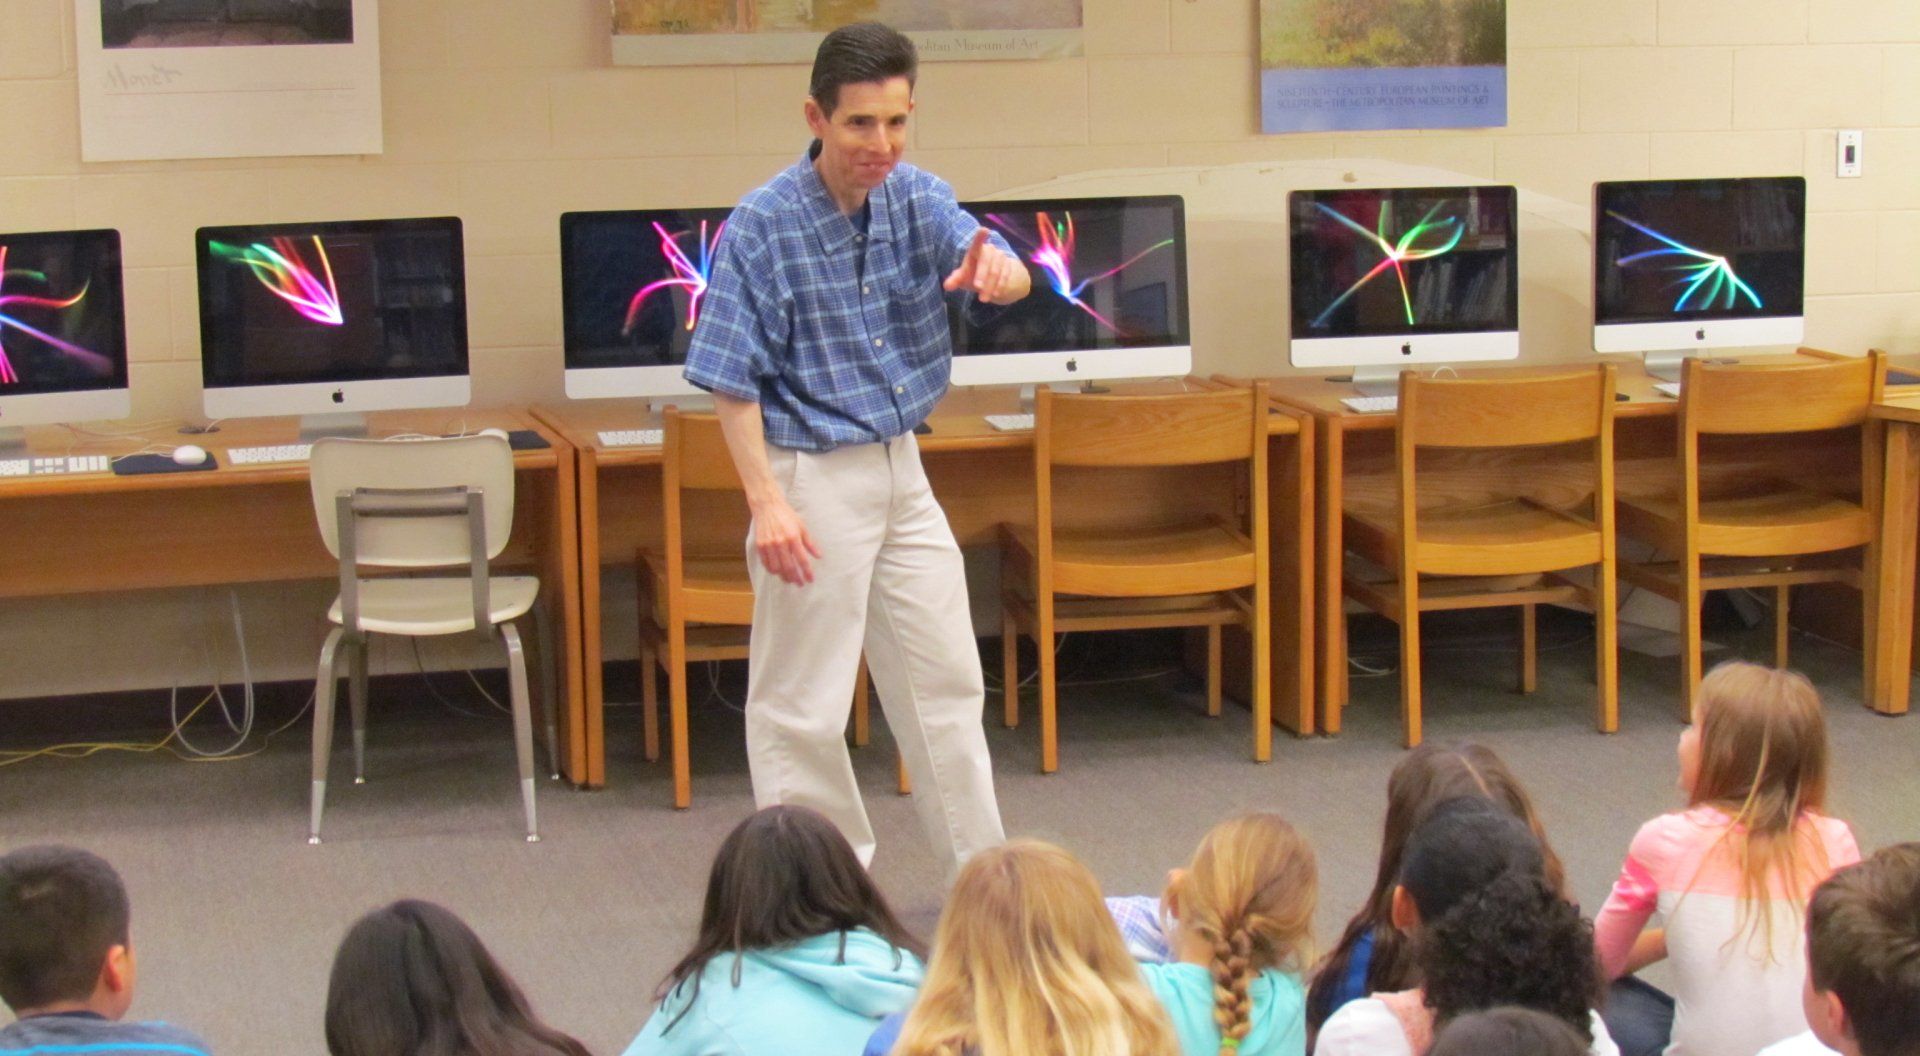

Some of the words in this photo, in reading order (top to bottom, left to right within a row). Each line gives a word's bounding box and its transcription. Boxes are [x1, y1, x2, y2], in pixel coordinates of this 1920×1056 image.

[955, 38, 1002, 52] Museum
[1006, 37, 1015, 50] of
[1020, 36, 1039, 49] Art
[1381, 85, 1428, 95] EUROPEAN
[1431, 84, 1480, 94] PAINTINGS
[1418, 96, 1455, 106] MUSEUM
[1471, 95, 1489, 105] ART
